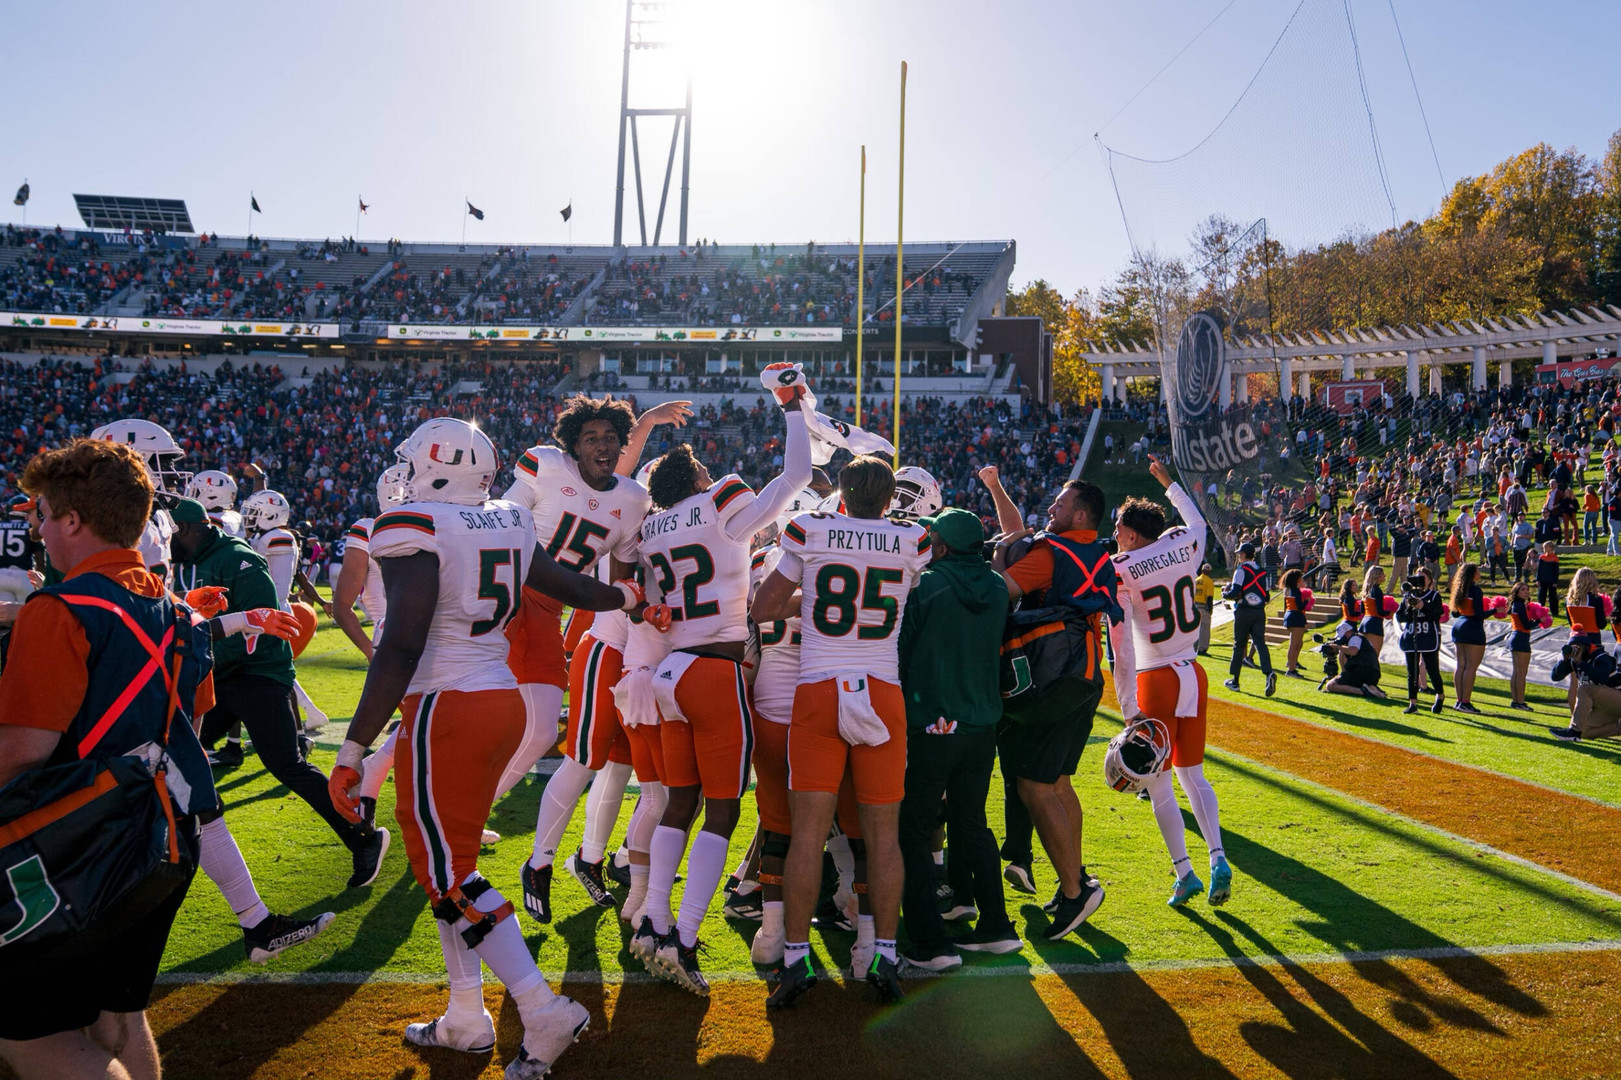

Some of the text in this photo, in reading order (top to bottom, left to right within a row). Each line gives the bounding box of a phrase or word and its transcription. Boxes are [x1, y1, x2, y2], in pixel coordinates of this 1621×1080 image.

[103, 233, 159, 246] VIRGINA
[459, 510, 508, 531] SCAIFE
[643, 513, 680, 542] RAVES
[685, 506, 707, 528] JR.
[546, 510, 611, 573] 15
[827, 529, 901, 554] PRZYTULA
[1127, 546, 1191, 580] BORREGALES
[469, 548, 522, 638] 51
[812, 562, 904, 641] 85
[1140, 574, 1202, 644] 30
[268, 924, 313, 951] ADIZERO
